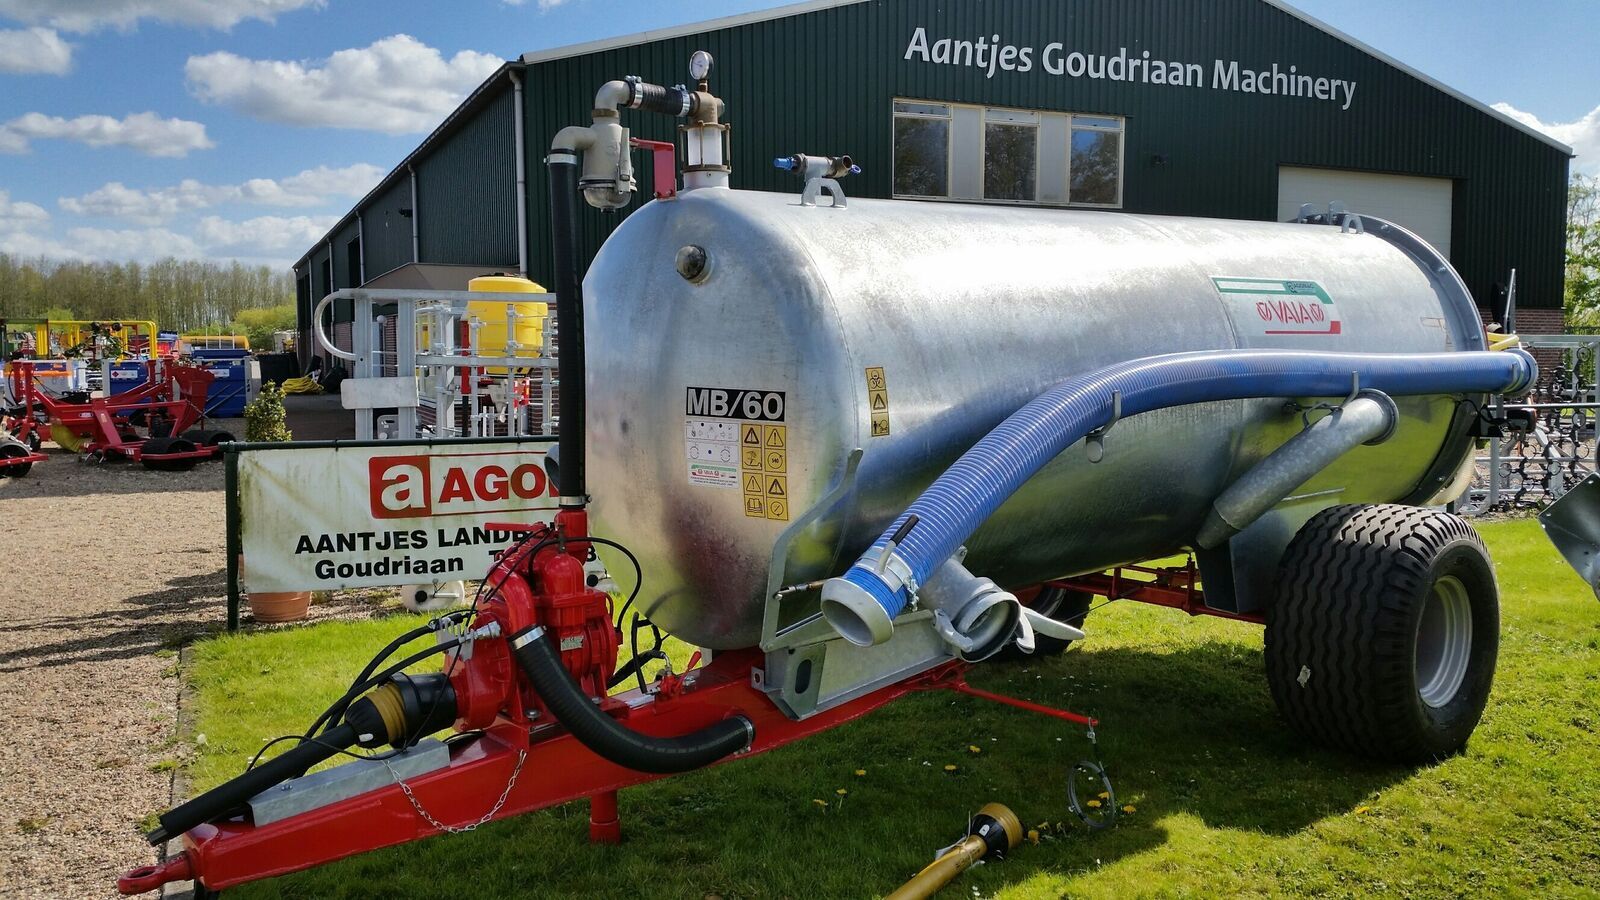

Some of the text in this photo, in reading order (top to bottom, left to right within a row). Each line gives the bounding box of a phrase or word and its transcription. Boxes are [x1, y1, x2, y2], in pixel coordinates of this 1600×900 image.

[904, 27, 1357, 110] Aantjes Goudriaan Machinery
[687, 388, 784, 420] MB/60
[438, 463, 560, 503] AGO
[295, 529, 428, 555] AANTJES
[315, 556, 464, 580] Goudriaan
